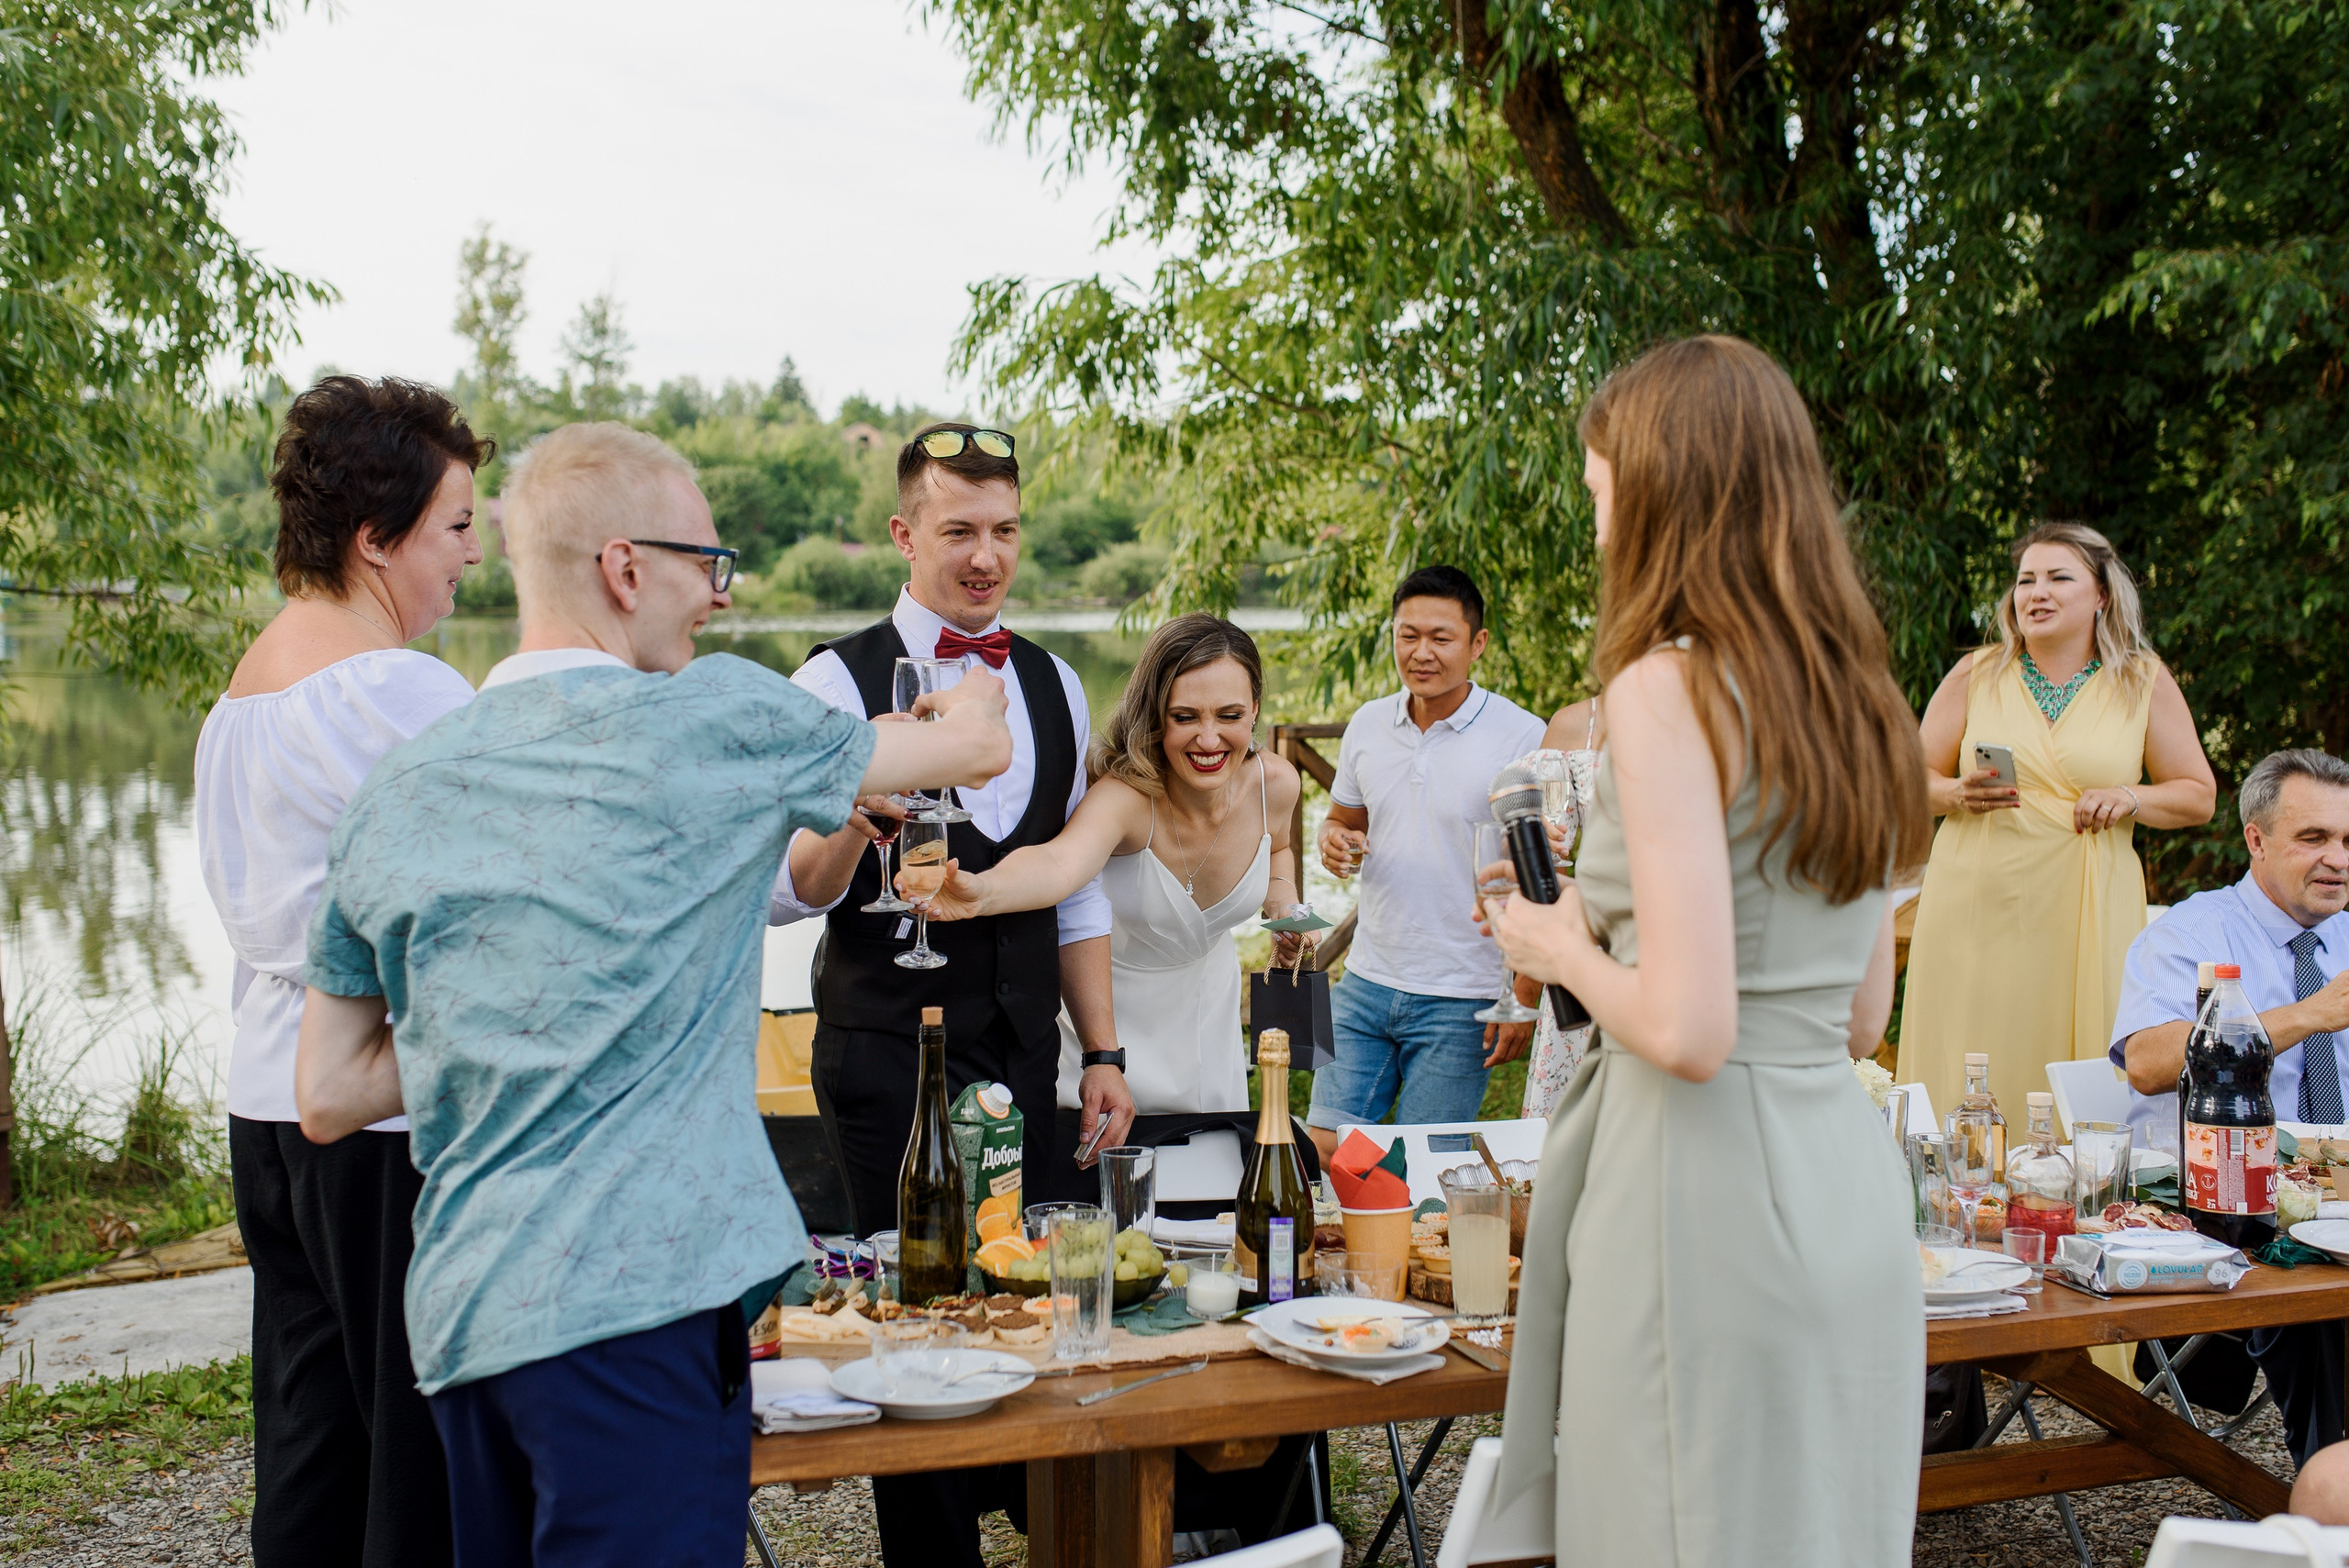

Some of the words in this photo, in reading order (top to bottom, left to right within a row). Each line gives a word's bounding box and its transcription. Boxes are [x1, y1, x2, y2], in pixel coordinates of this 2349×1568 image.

[981, 1140, 1023, 1171] Добры
[2158, 1264, 2203, 1274] LOVULAR
[2214, 1268, 2229, 1278] 96
[748, 1319, 778, 1338] ESON
